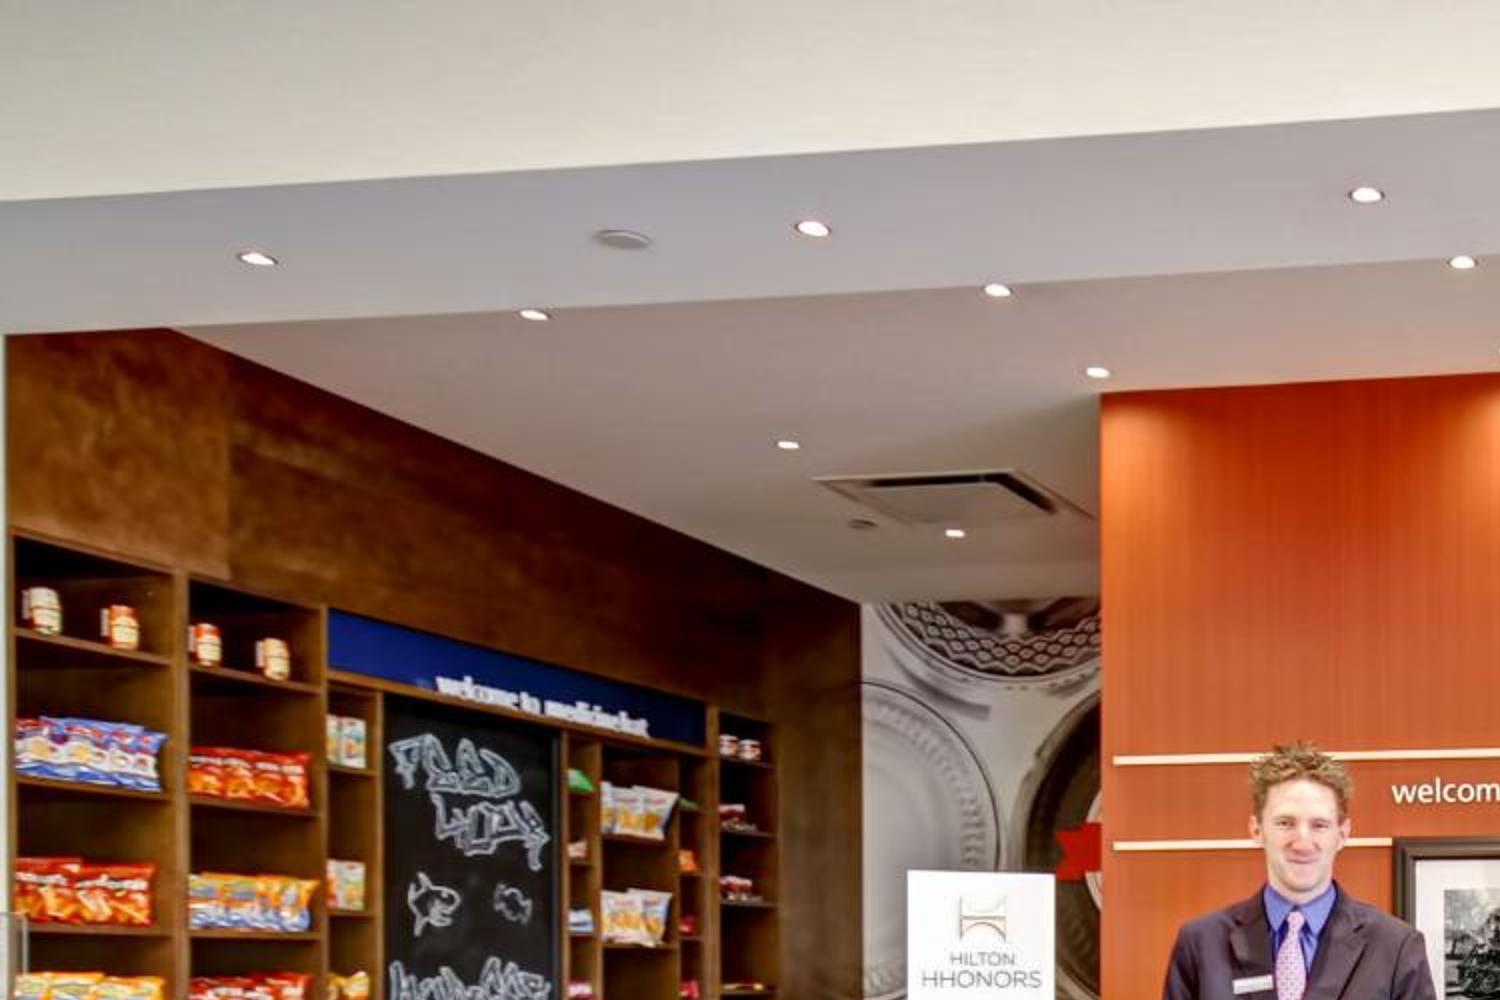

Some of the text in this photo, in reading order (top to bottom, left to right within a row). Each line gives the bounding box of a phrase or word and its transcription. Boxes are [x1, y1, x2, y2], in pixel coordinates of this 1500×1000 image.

[388, 734, 521, 798] FEED
[949, 951, 1016, 967] HILTON
[922, 969, 1043, 989] HHONORS
